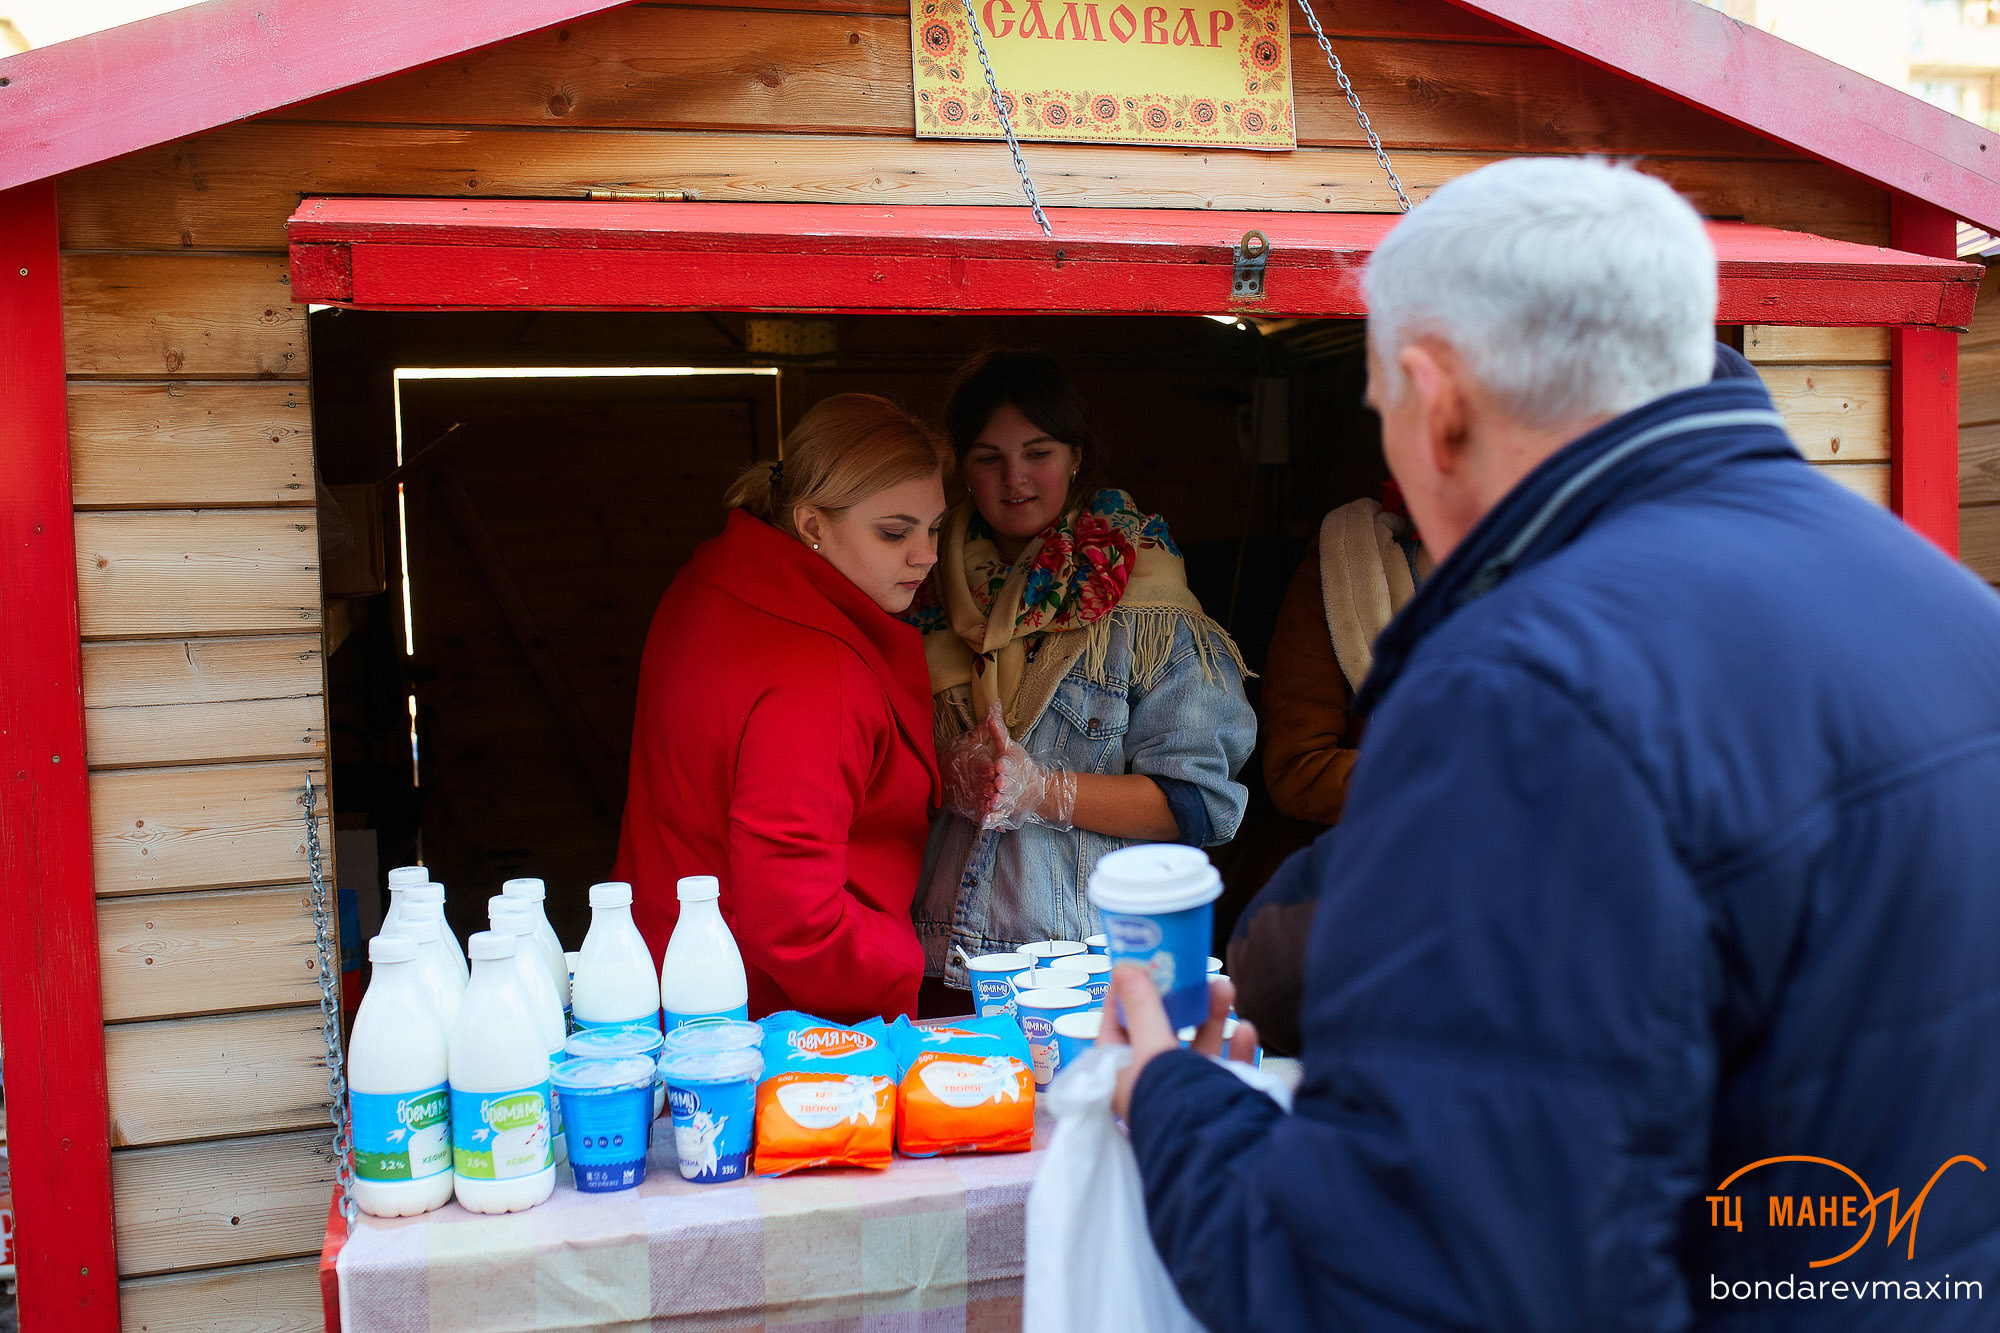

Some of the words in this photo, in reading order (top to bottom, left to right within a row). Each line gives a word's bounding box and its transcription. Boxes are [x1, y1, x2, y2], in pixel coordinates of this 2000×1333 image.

[982, 0, 1234, 48] САМОВАР
[944, 1084, 983, 1093] ТВОРОГ
[800, 1104, 841, 1114] ТВОРОГ
[380, 1159, 406, 1172] 3,2%
